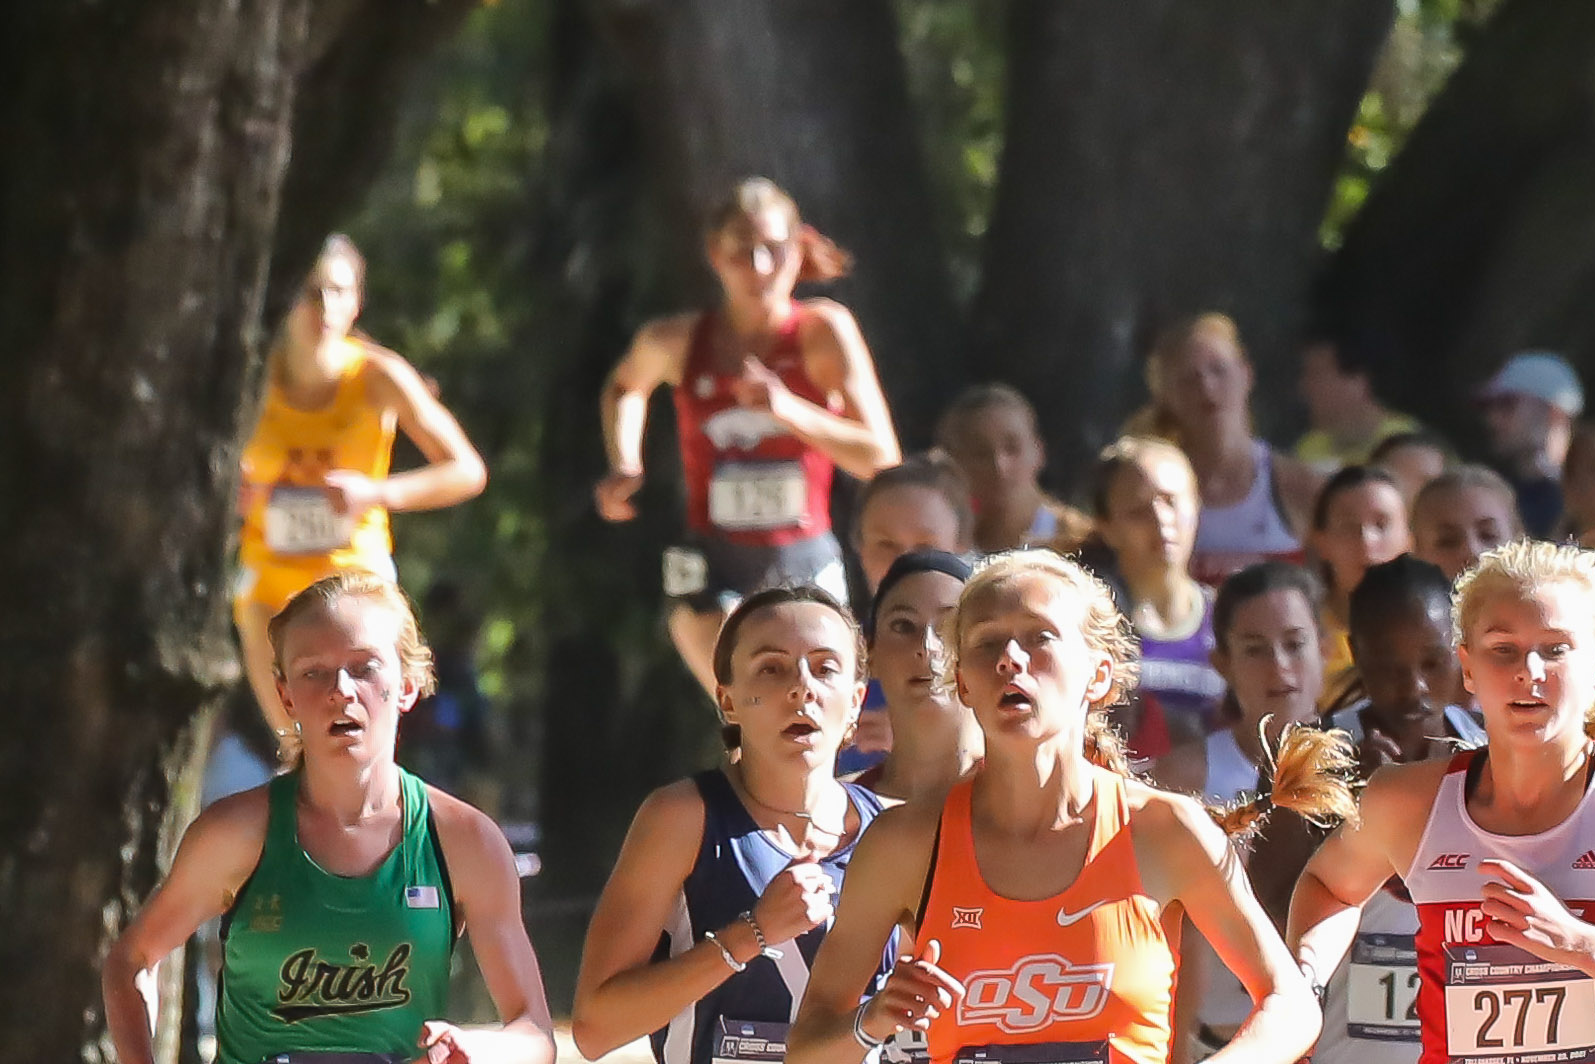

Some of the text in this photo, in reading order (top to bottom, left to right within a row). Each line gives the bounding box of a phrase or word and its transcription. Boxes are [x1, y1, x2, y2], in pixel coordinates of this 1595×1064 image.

[1428, 854, 1470, 869] ACC
[278, 943, 412, 1008] Irish
[961, 957, 1108, 1030] OSU
[1474, 987, 1566, 1048] 277
